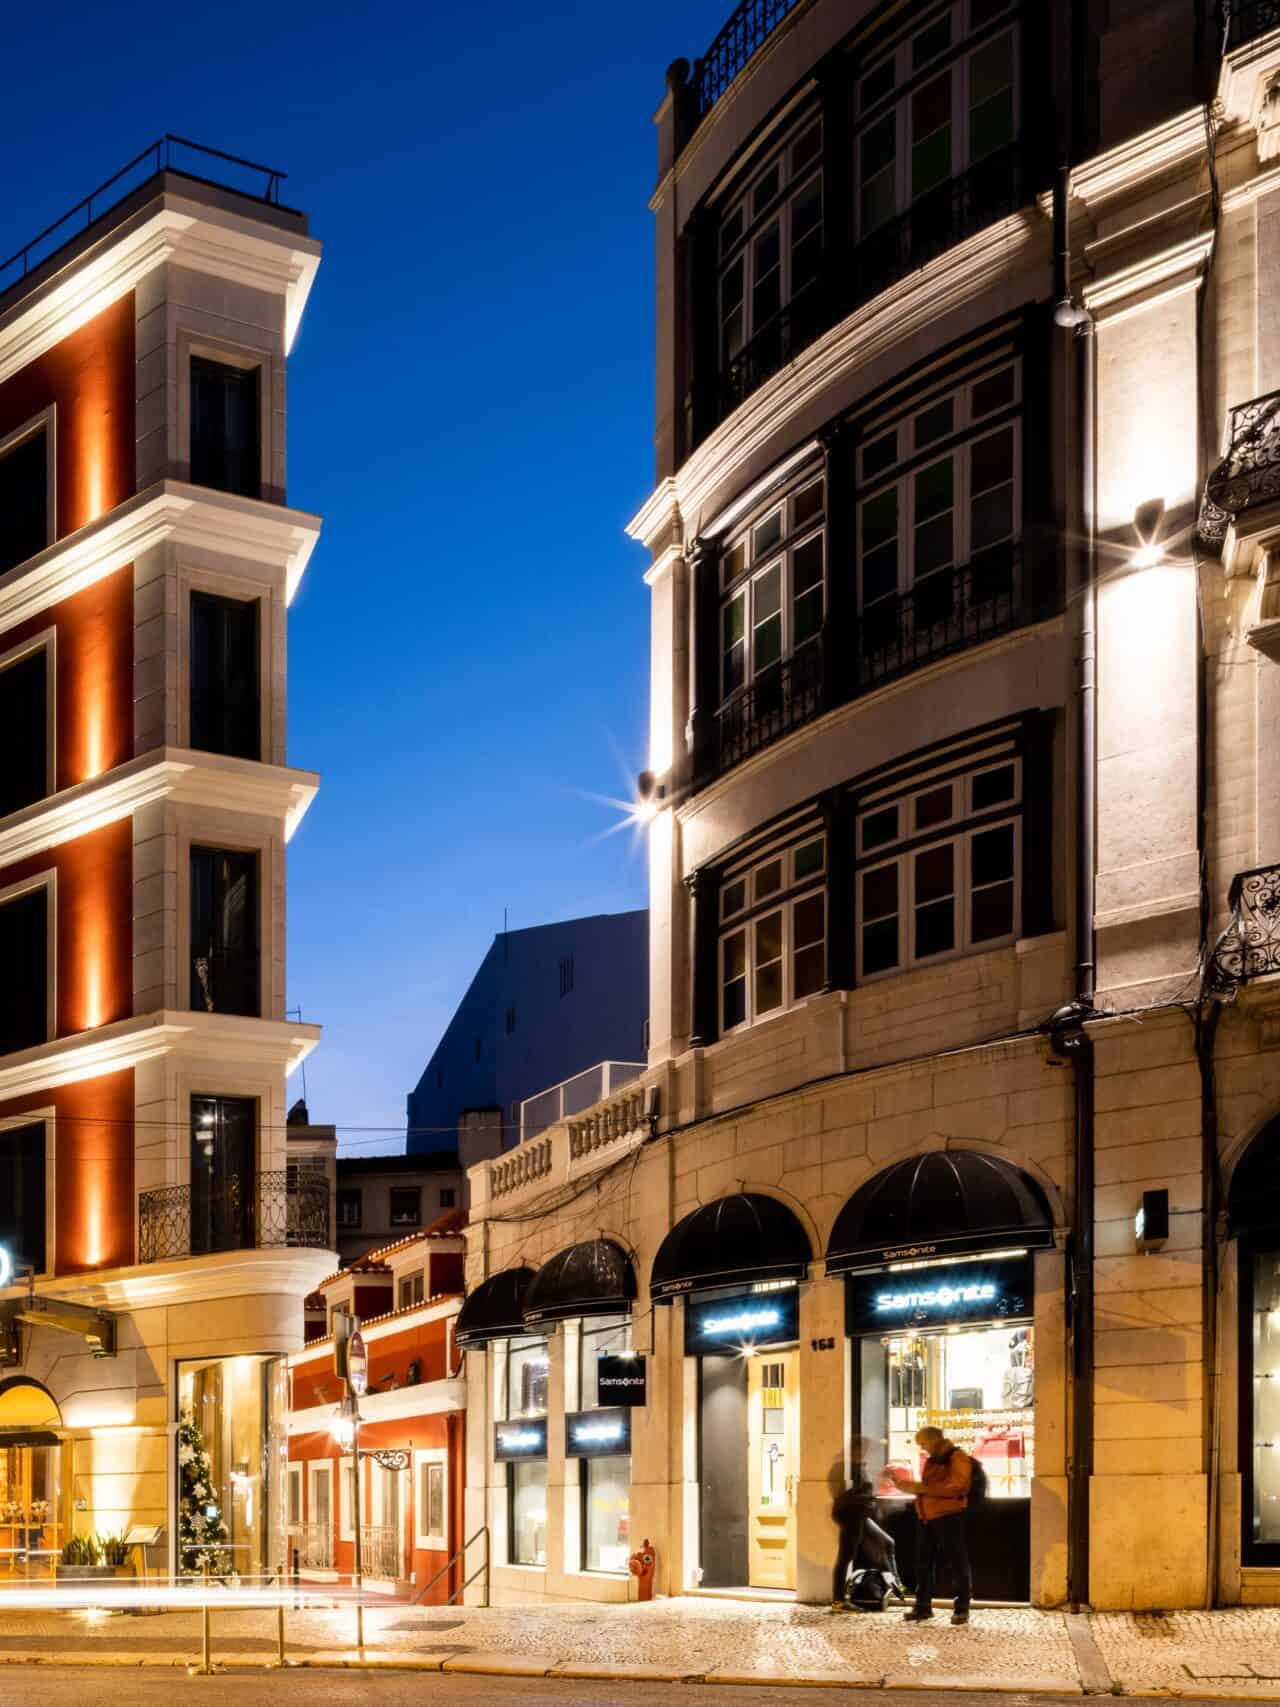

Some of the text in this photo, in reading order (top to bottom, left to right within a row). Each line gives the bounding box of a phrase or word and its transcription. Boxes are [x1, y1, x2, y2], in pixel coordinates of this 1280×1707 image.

[882, 1245, 936, 1260] Samsonite
[876, 1284, 996, 1311] Samsonite
[599, 1377, 645, 1387] Samsonite
